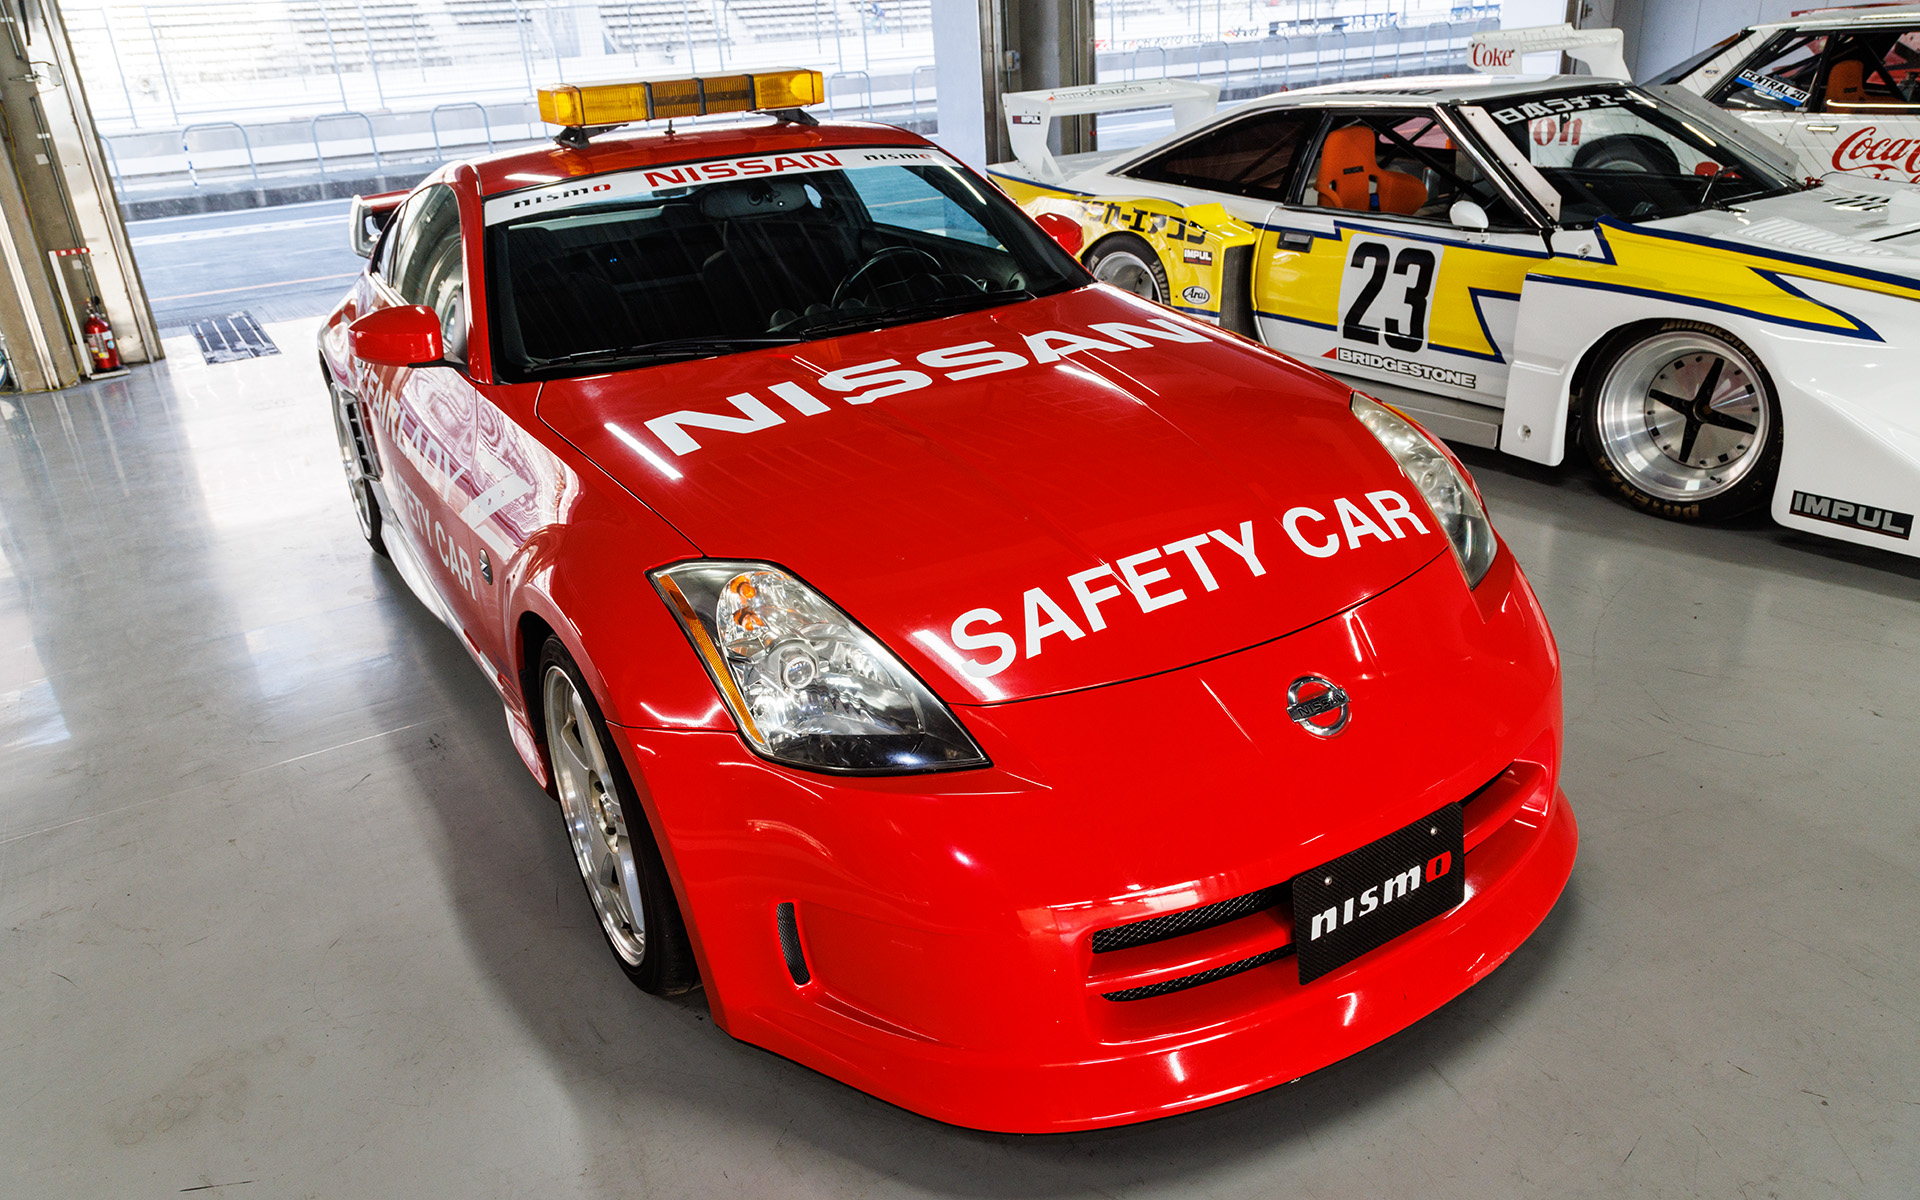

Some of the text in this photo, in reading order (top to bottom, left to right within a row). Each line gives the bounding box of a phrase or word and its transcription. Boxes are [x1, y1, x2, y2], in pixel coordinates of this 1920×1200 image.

[1472, 42, 1514, 67] Coke
[1741, 70, 1808, 101] CENTRAL 20
[512, 150, 932, 209] nismo NISSAN nismo
[1184, 249, 1212, 261] IMPUL
[1187, 288, 1209, 300] Arai
[1343, 242, 1435, 353] 23
[643, 319, 1212, 456] NISSAN
[1338, 348, 1476, 389] BRIDGESTONE
[365, 372, 466, 503] FAIRLADY
[1793, 491, 1905, 534] IMPUL
[434, 521, 477, 600] CAR
[949, 489, 1431, 678] SAFETY CAR
[1297, 688, 1346, 717] NISSAN
[1310, 850, 1452, 941] nismo
